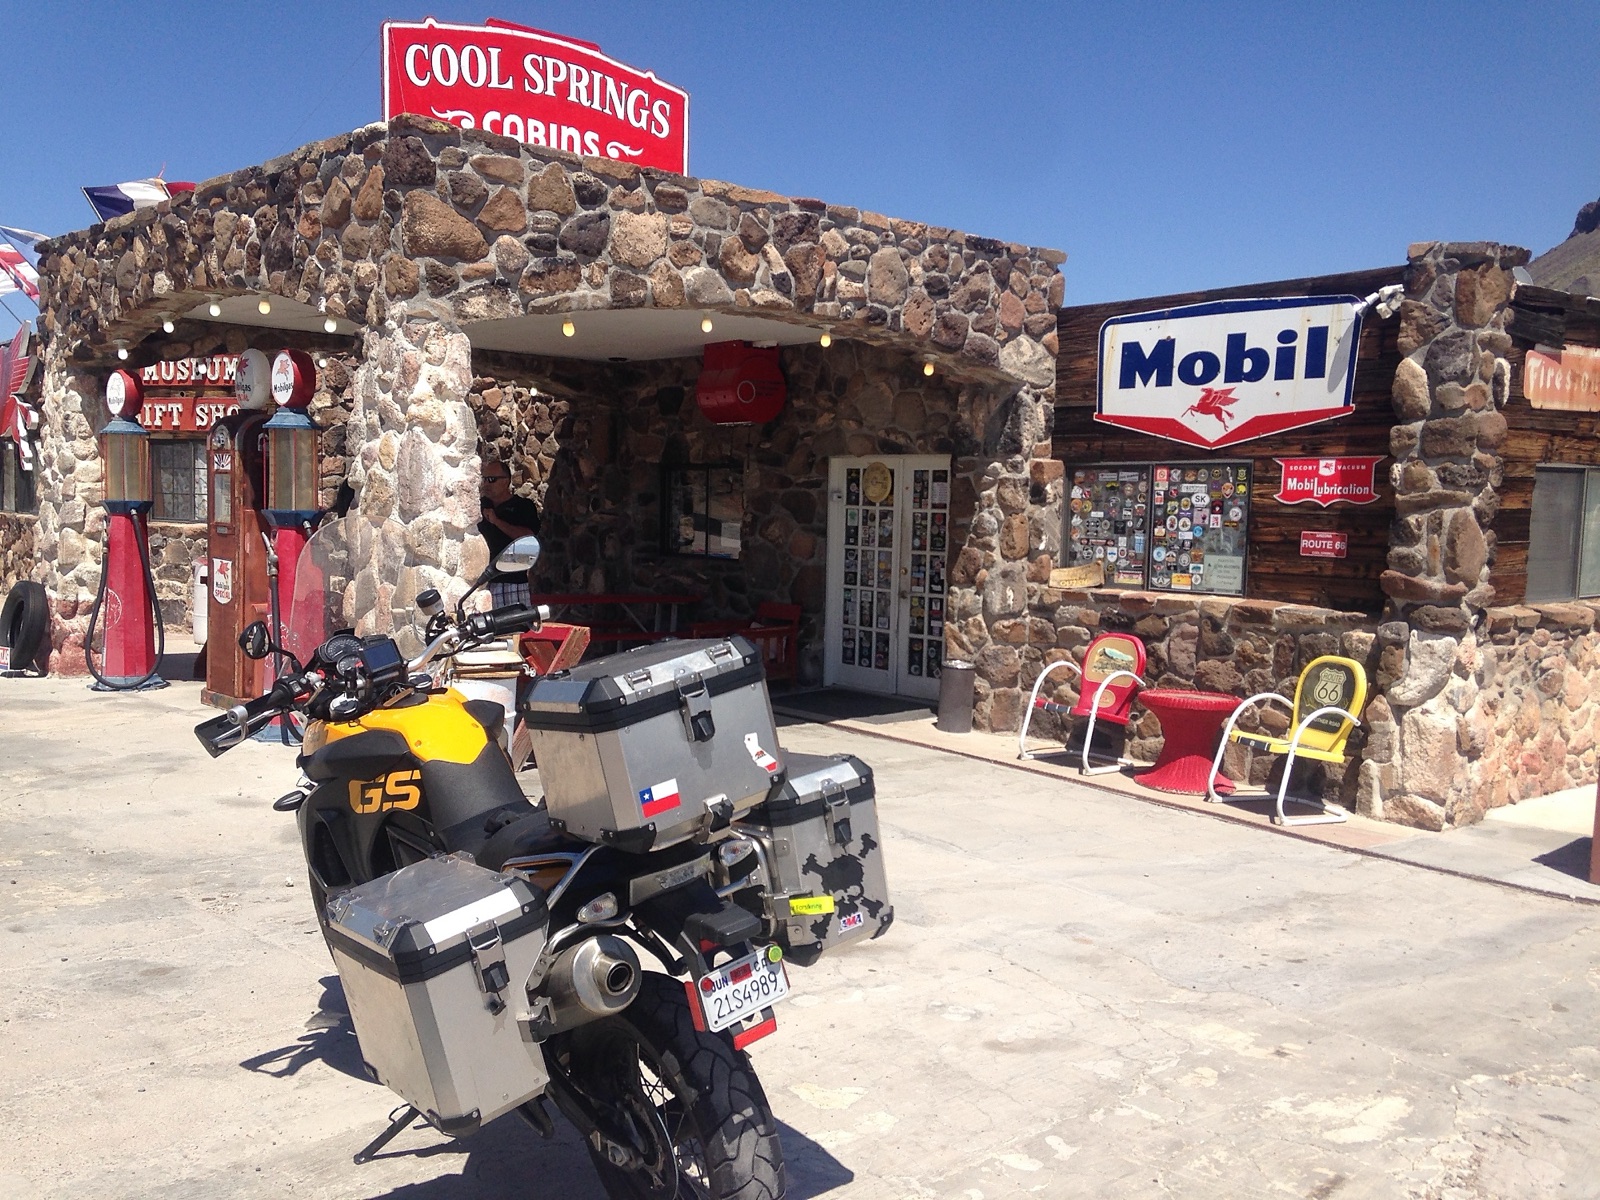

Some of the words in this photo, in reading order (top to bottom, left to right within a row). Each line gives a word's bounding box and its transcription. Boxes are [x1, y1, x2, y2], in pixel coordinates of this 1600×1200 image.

[405, 43, 513, 90] COOL
[523, 53, 671, 138] SPRINGS
[1118, 325, 1329, 390] Mobil
[135, 403, 184, 426] IFT
[1194, 494, 1207, 503] SK
[1302, 539, 1334, 549] ROUTE
[1335, 541, 1346, 550] 66
[1323, 672, 1343, 682] ROUTE
[1318, 682, 1339, 702] 66
[349, 769, 421, 814] GS
[713, 971, 778, 1019] 21S4989
